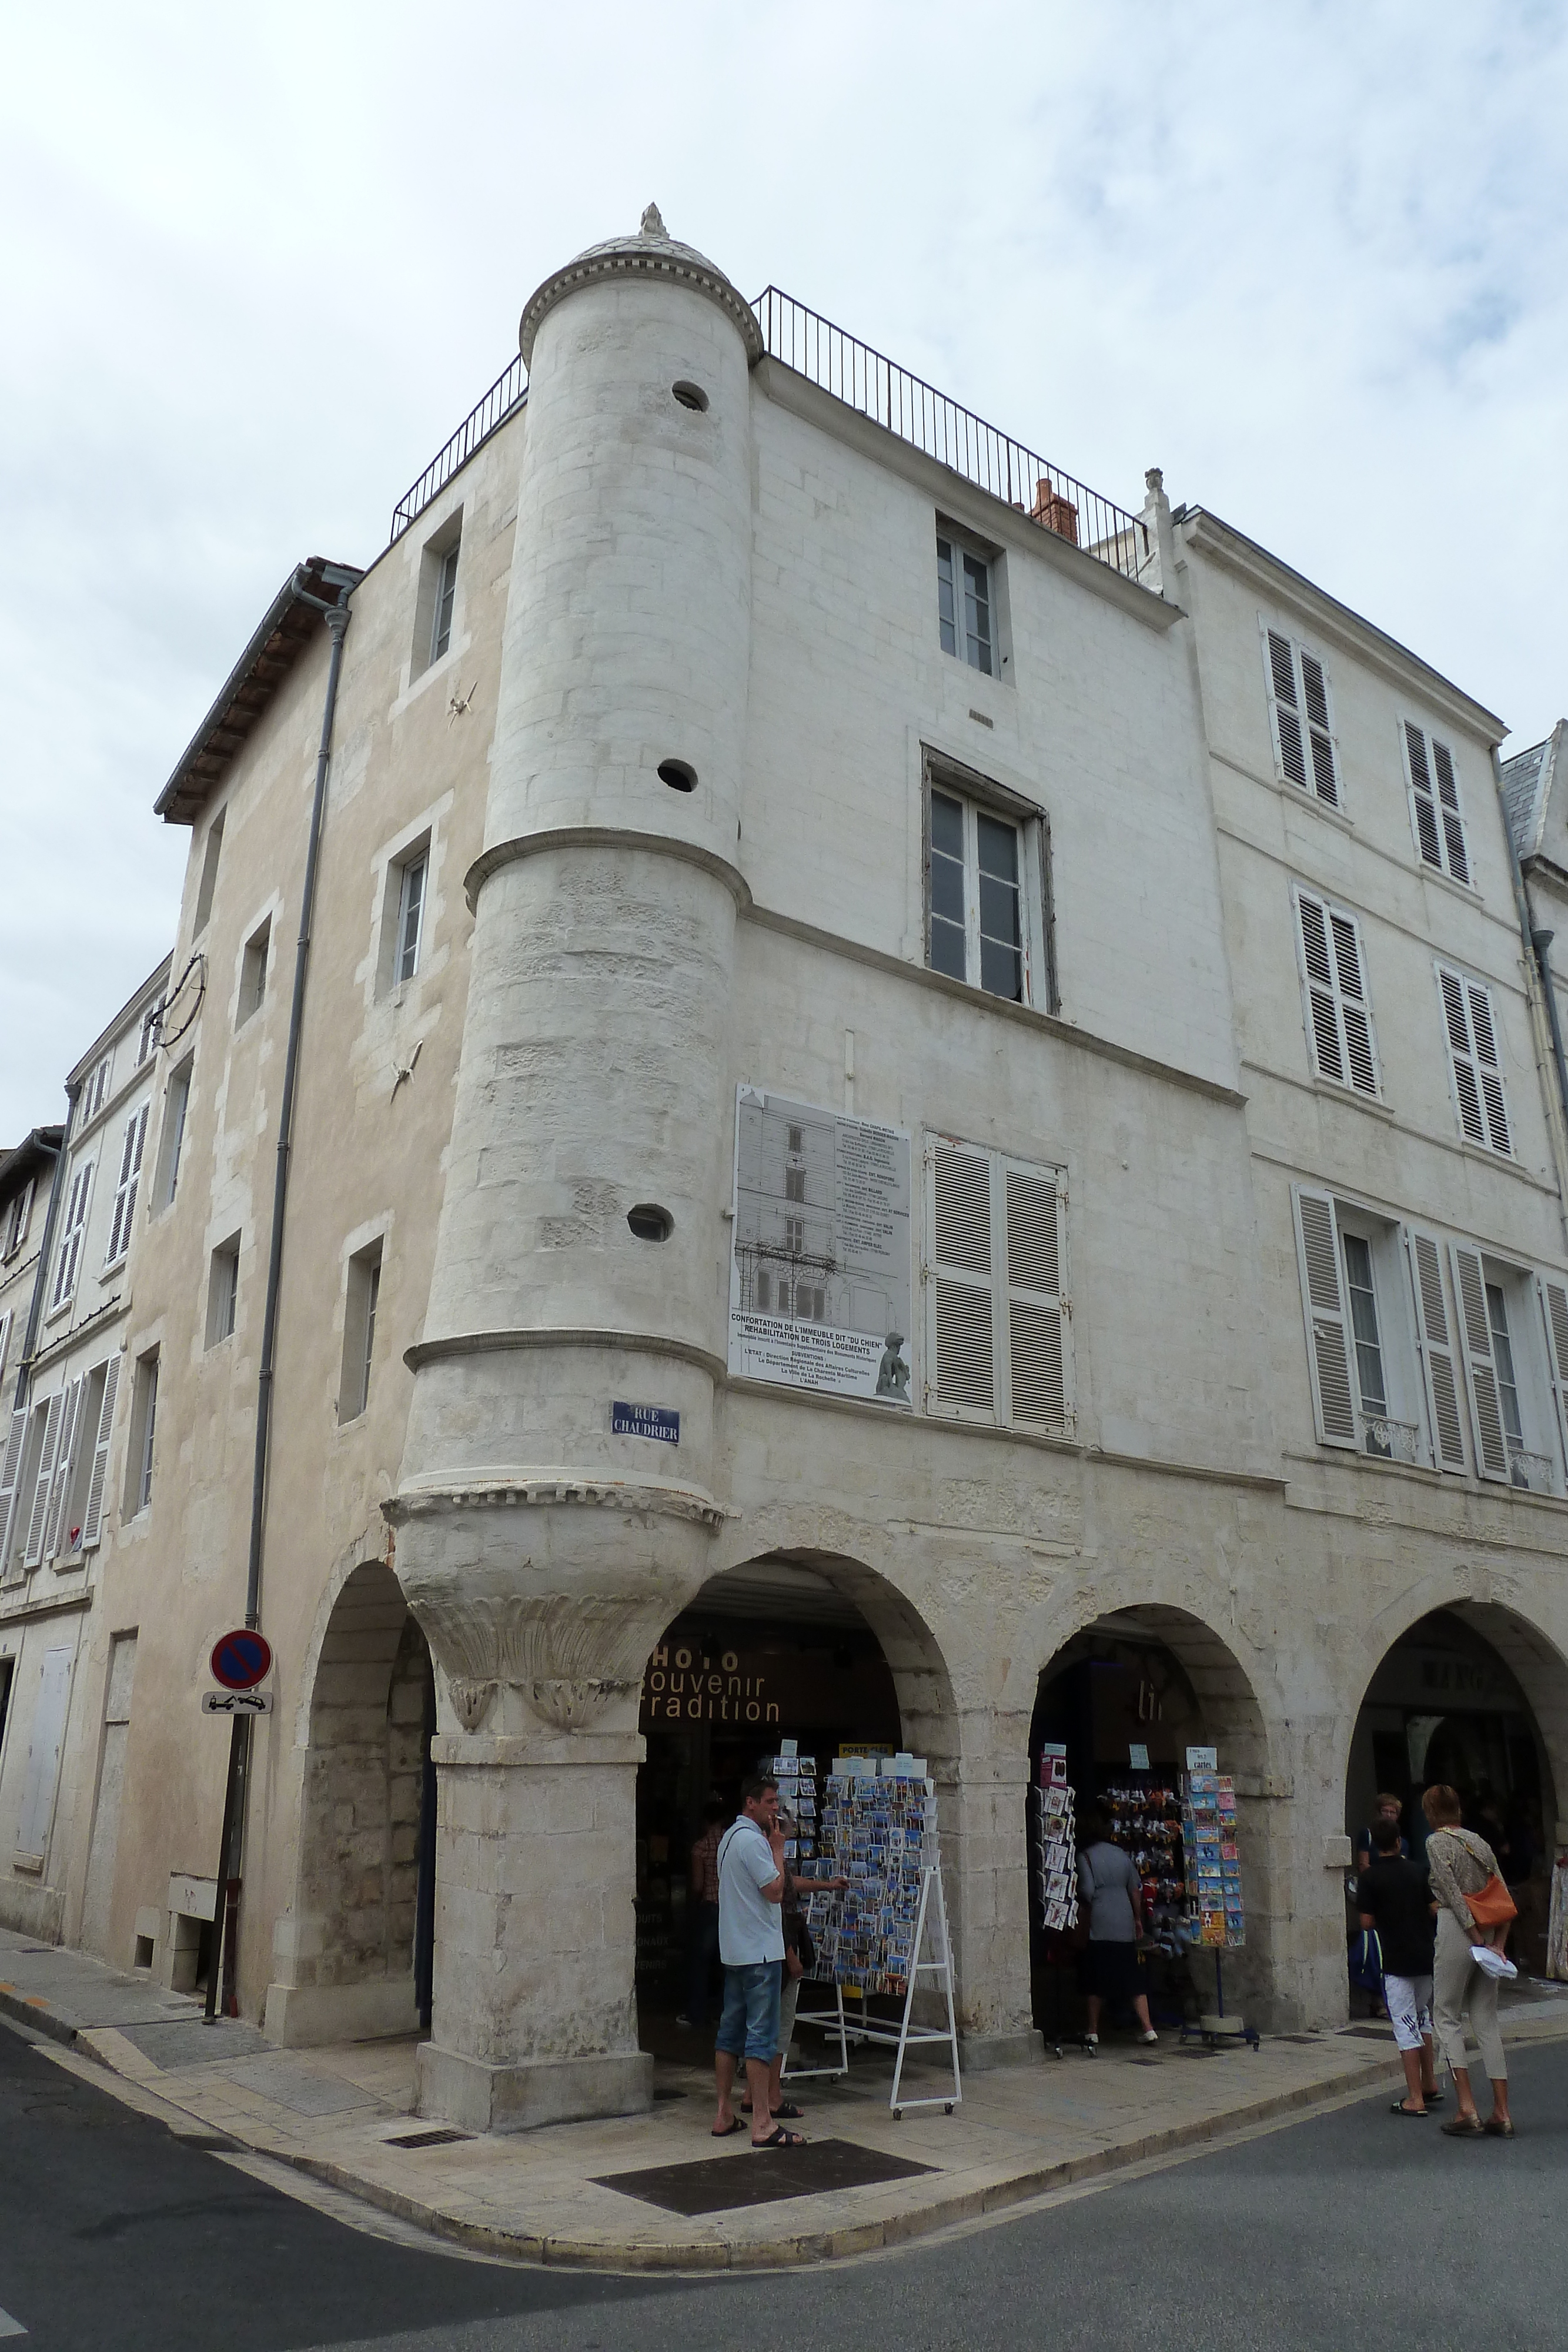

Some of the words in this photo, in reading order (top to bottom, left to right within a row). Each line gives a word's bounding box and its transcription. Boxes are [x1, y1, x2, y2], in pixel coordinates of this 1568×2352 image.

[731, 1314, 783, 1329] CONFORTATION
[795, 1326, 834, 1339] L'IMMEUBLE
[847, 1336, 859, 1344] "DU
[861, 1338, 882, 1348] CHIEN"
[745, 1325, 799, 1341] REHABILITATION
[811, 1337, 830, 1347] TROIS
[833, 1341, 870, 1355] LOGEMENTS
[737, 1332, 756, 1340] Immeuble
[774, 1339, 795, 1348] l'Inventaire
[834, 1350, 855, 1359] Monuments
[857, 1354, 877, 1362] Historiques
[792, 1351, 824, 1361] SUBVENTIONS
[766, 1352, 789, 1361] Direction
[845, 1367, 870, 1375] Culturelles
[766, 1359, 798, 1369] Département
[814, 1367, 835, 1376] Charente
[837, 1371, 857, 1379] Maritime
[634, 1407, 659, 1422] RUE
[614, 1419, 677, 1440] CHAUDRIER
[641, 1671, 764, 1696] ouvenir
[641, 1694, 779, 1722] radition
